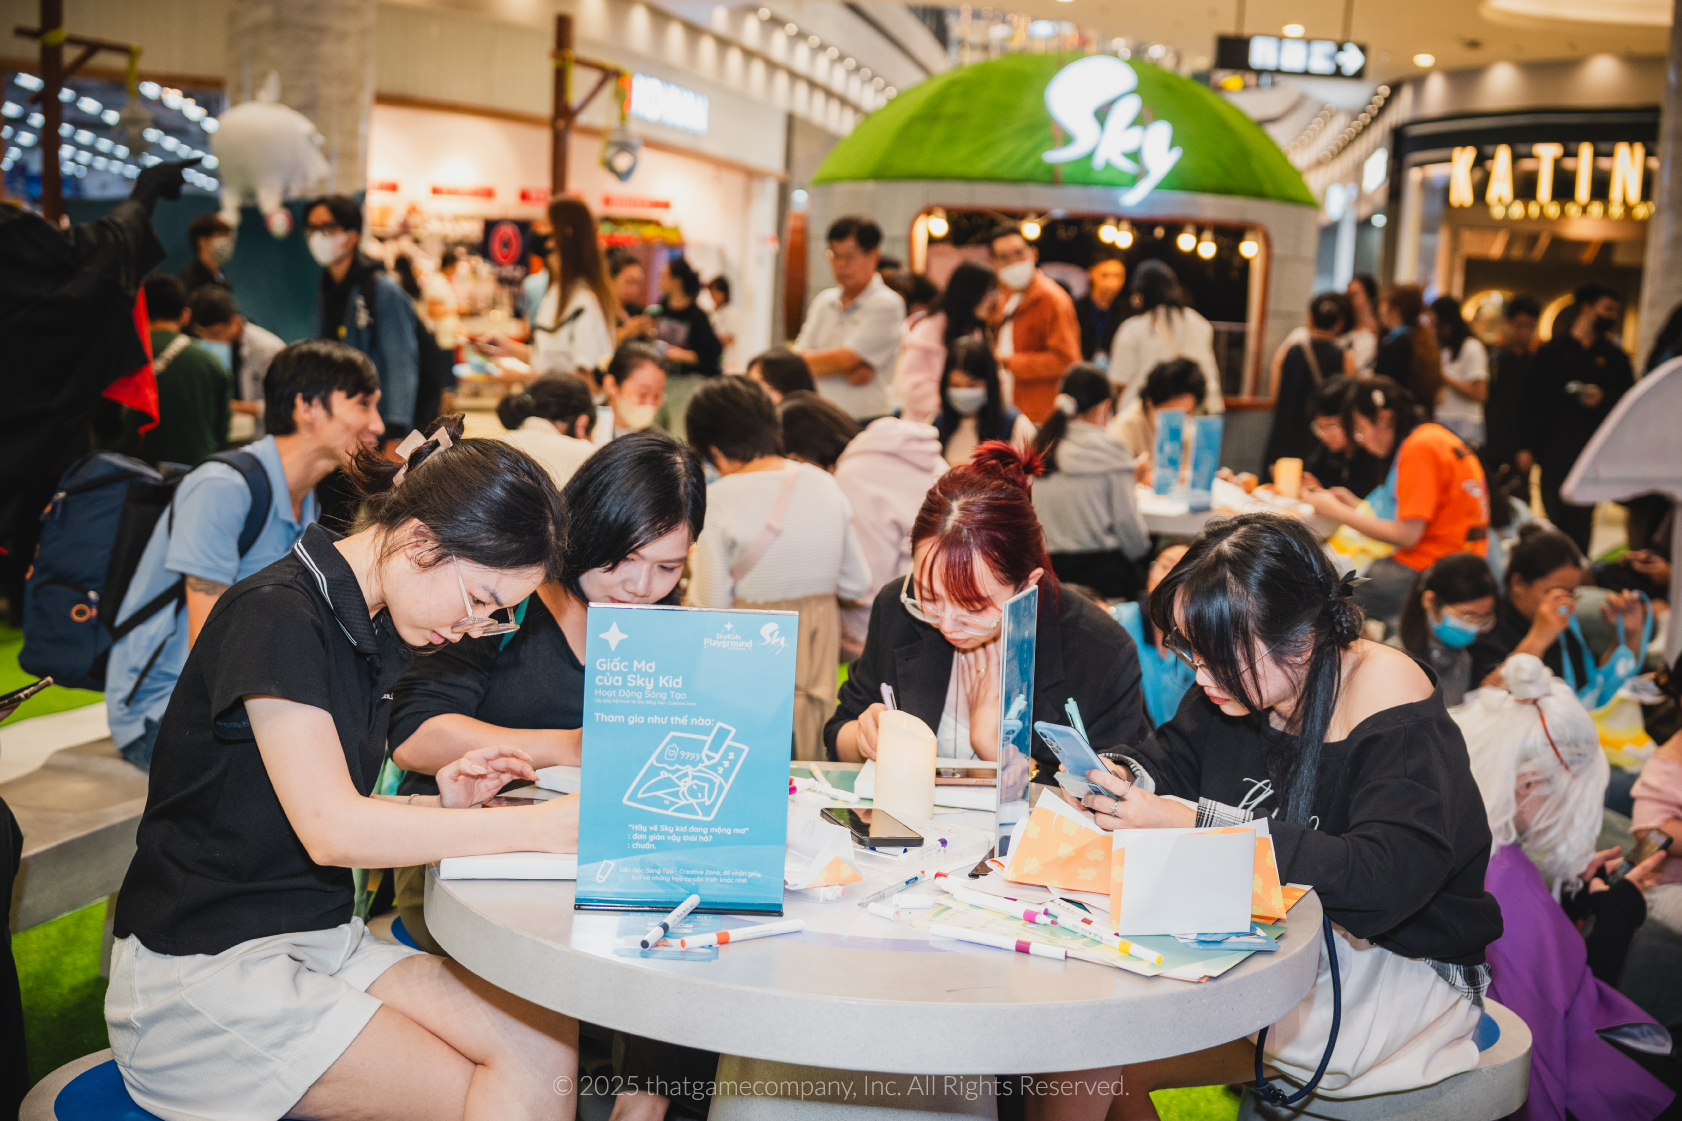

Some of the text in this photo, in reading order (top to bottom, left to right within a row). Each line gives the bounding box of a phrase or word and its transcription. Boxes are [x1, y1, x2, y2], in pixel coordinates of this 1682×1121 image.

[1042, 55, 1183, 206] Sky
[704, 638, 753, 648] Playground
[716, 633, 741, 641] SkyKids
[757, 622, 788, 655] Sky
[596, 657, 656, 672] Giấc Mơ
[595, 672, 682, 690] của Sky Kid
[595, 688, 686, 700] Hoạt Động Sáng Tạo
[594, 712, 714, 726] Tham gia như thế nào:
[660, 825, 674, 833] Sky
[689, 825, 708, 834] đang
[710, 826, 731, 835] mộng
[649, 833, 665, 841] giản
